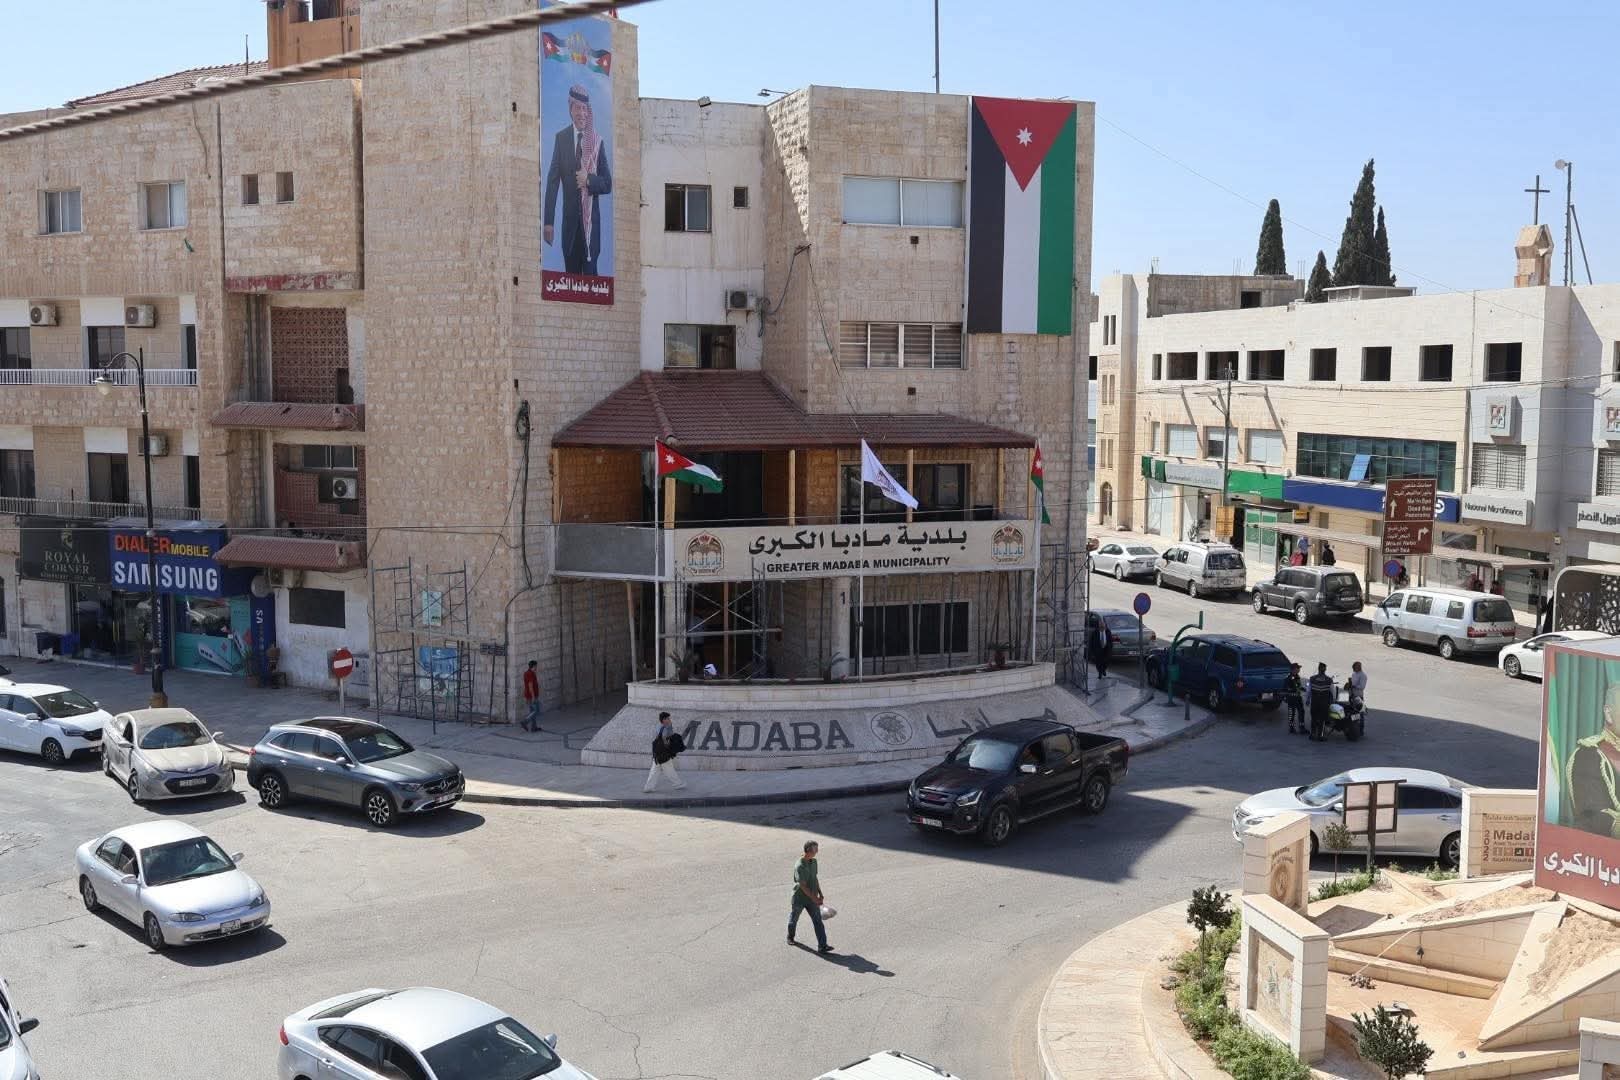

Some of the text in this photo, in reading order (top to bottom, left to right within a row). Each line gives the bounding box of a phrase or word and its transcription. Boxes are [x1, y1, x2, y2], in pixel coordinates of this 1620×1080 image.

[546, 276, 609, 296] بلدية مادبا الكبرى
[170, 543, 209, 557] MOBILE
[748, 525, 967, 558] بلدية مادبا الكبرى
[44, 550, 89, 564] ROYAL
[766, 556, 950, 573] GREATER MADABA MUNICIPALITY
[44, 561, 89, 574] CORNER
[114, 560, 218, 591] SAMSUNG
[1543, 851, 1595, 877] الكبرى
